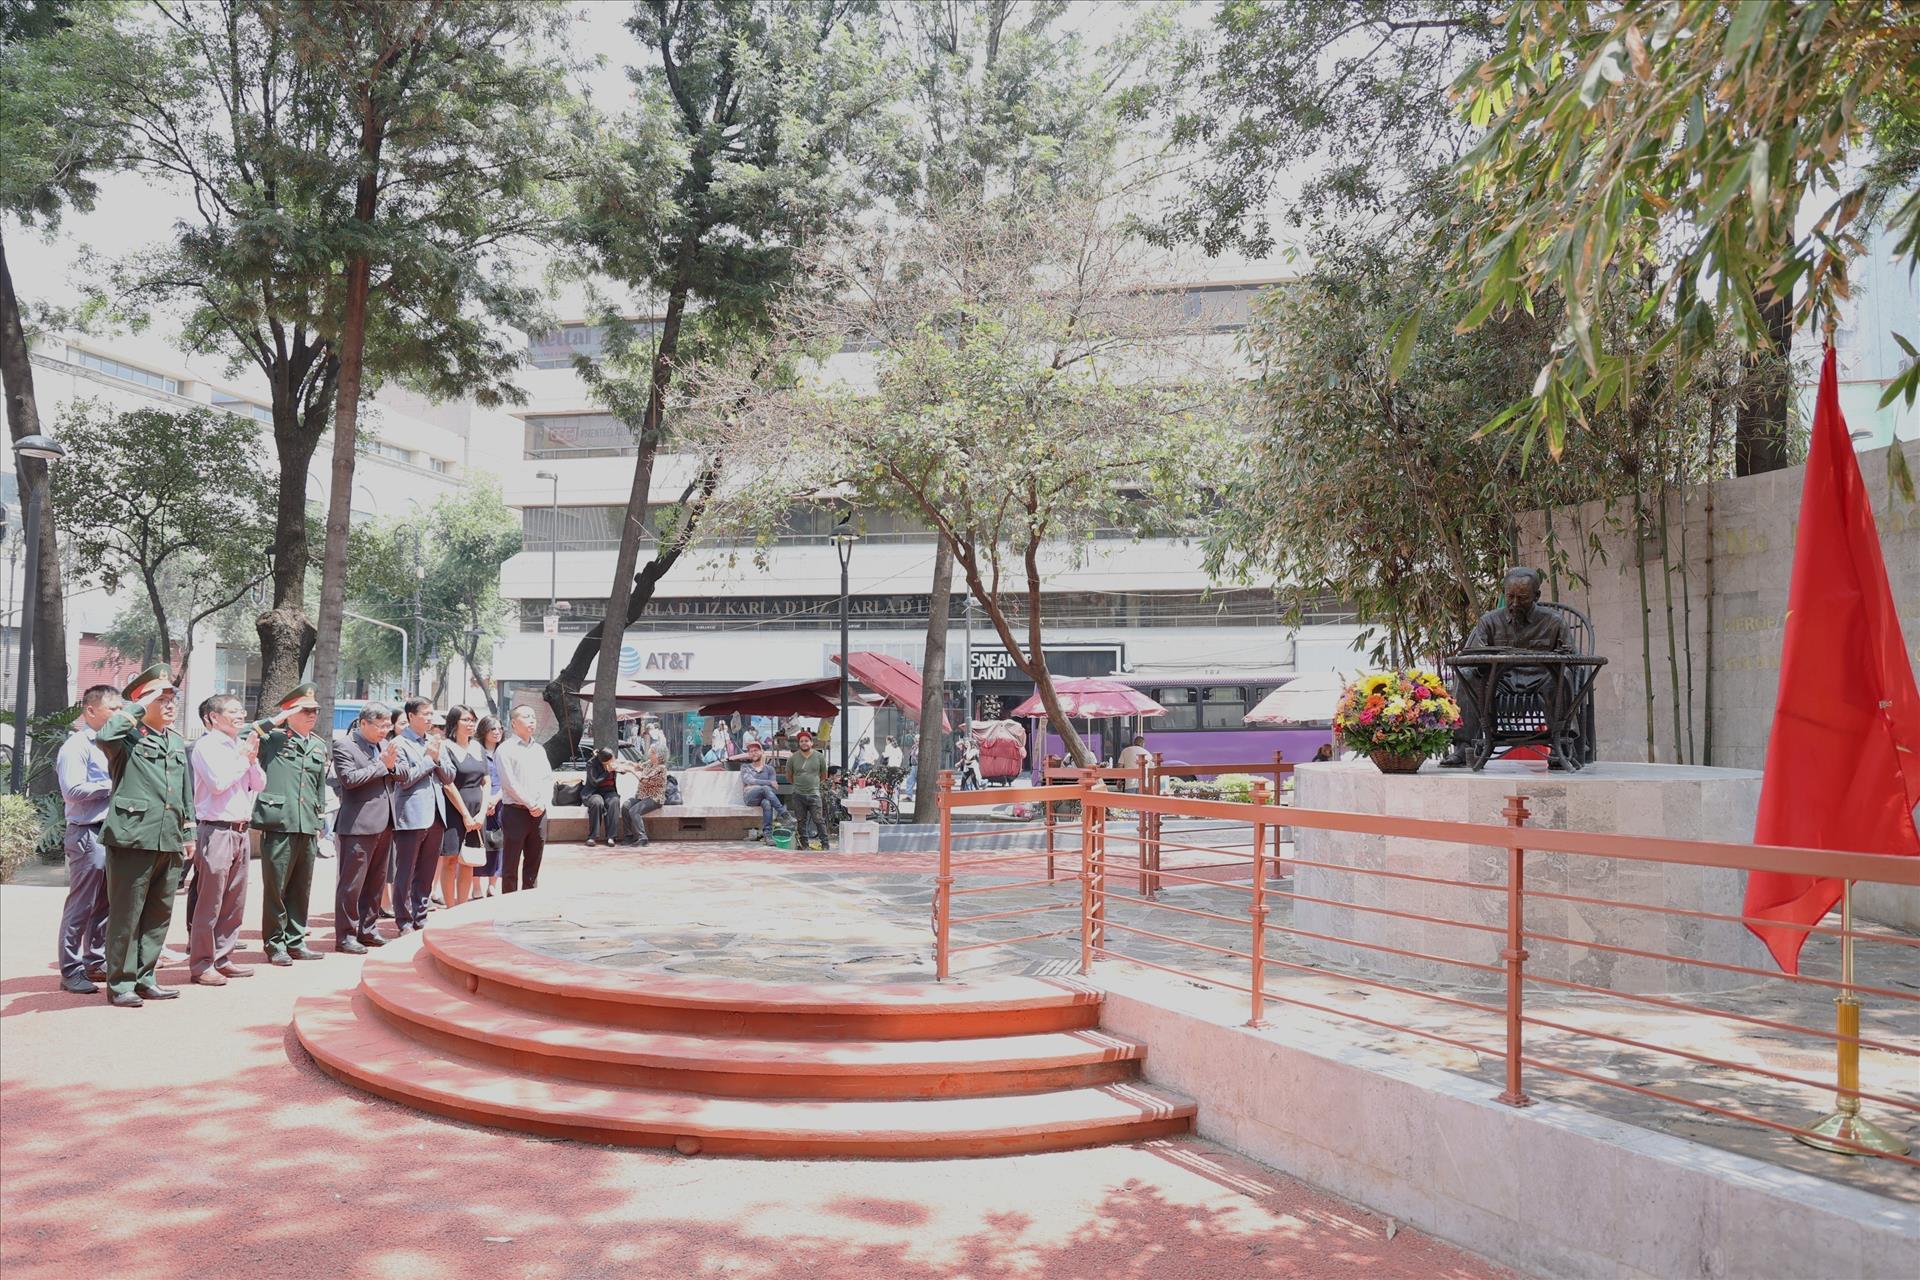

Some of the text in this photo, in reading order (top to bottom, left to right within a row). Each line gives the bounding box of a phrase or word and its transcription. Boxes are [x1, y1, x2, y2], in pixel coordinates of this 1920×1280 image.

[695, 601, 722, 616] LIZ
[725, 601, 781, 616] KARLA
[802, 600, 830, 615] LIZ
[645, 651, 695, 670] AT&T
[970, 667, 1006, 680] LAND
